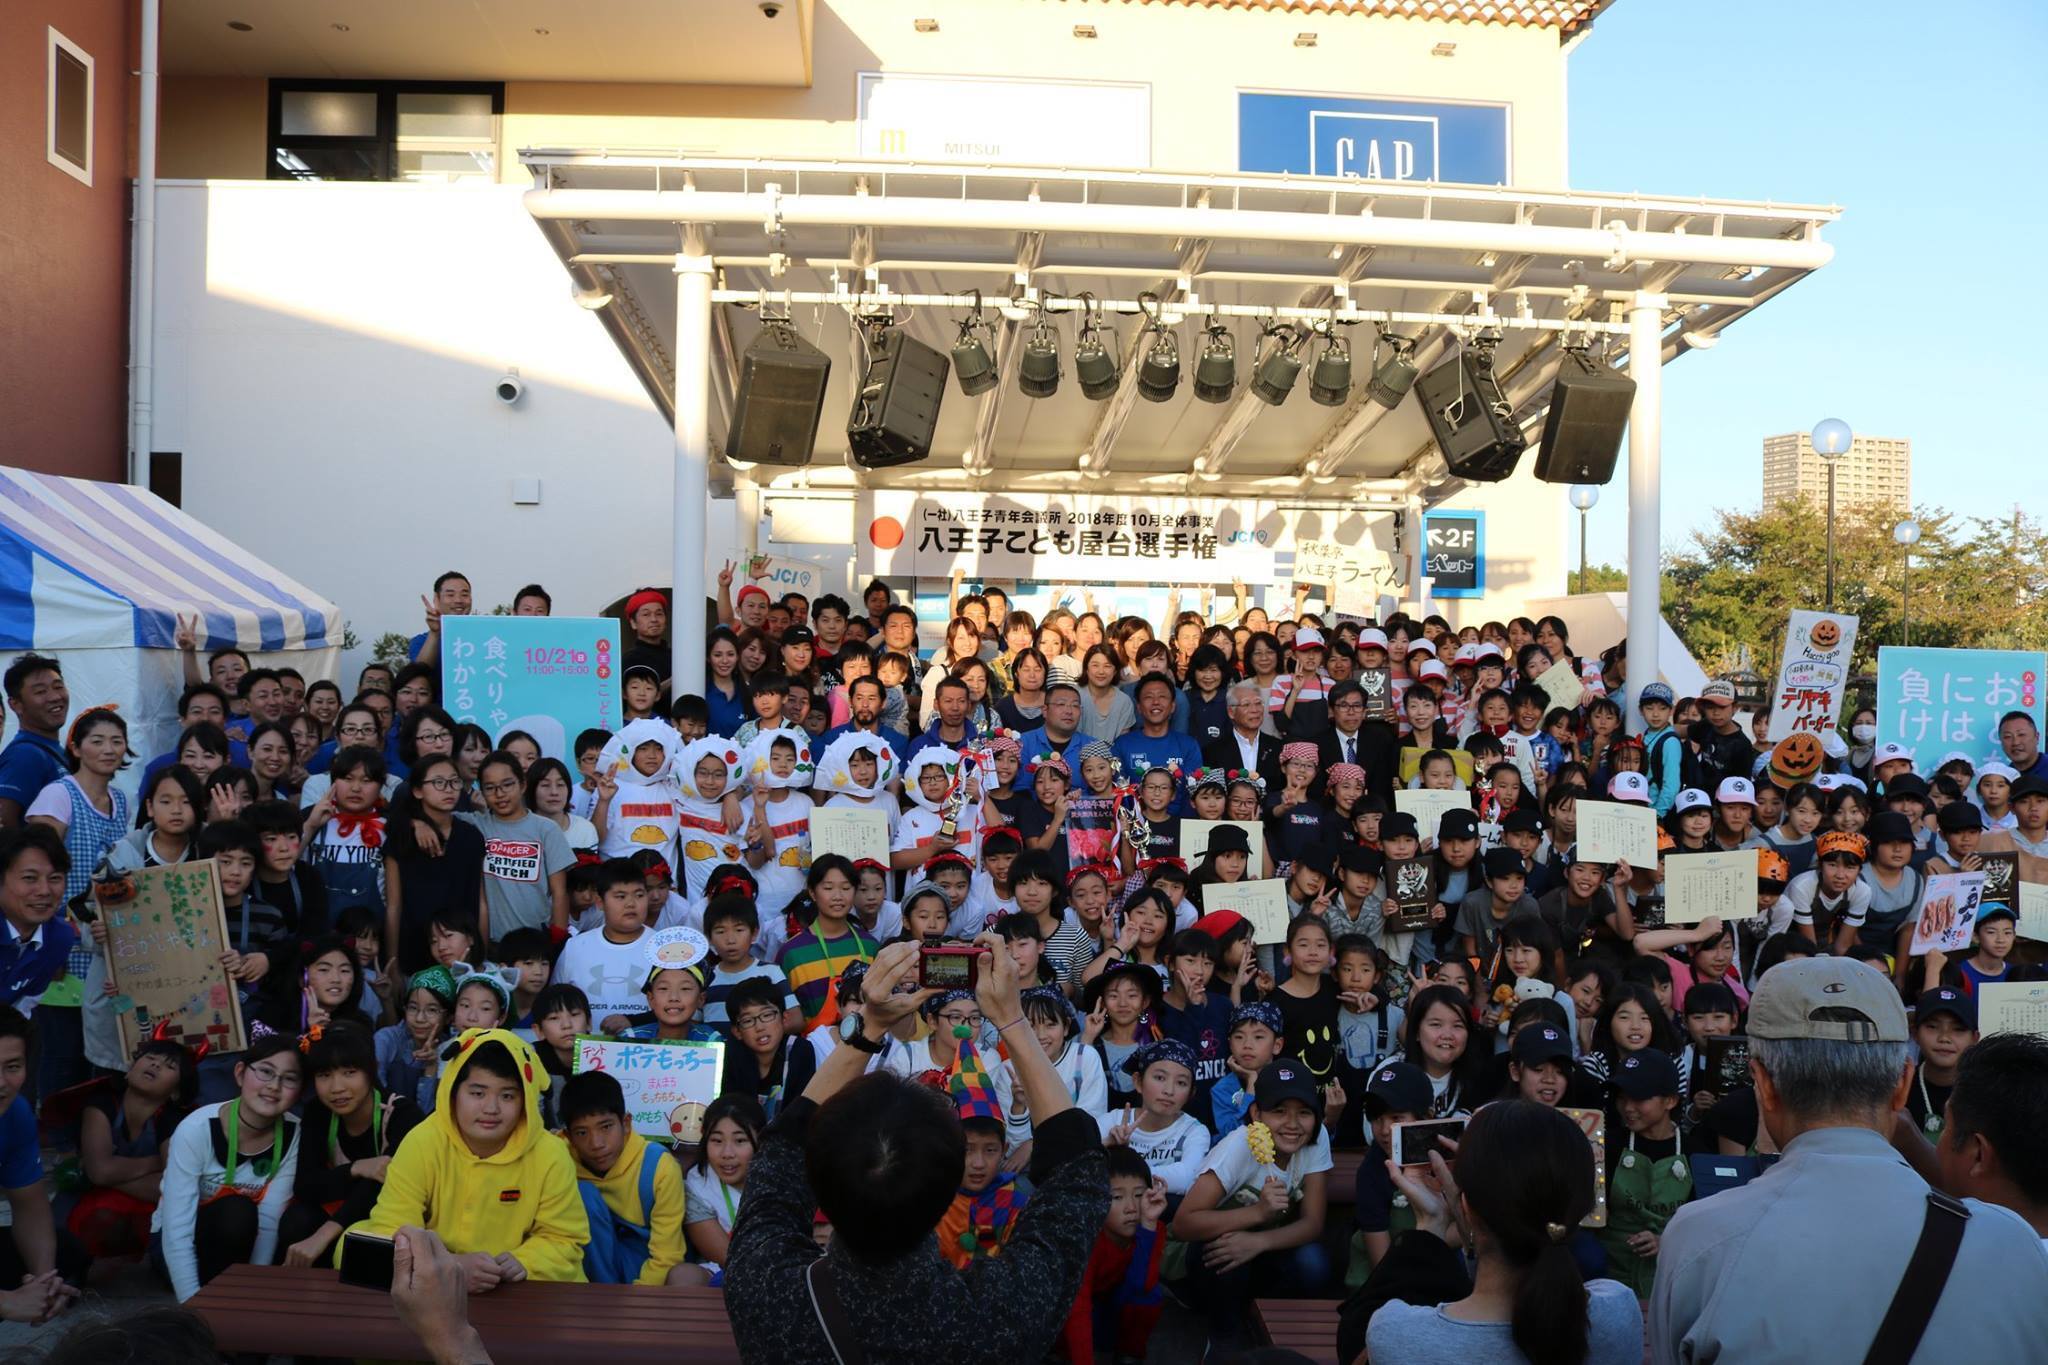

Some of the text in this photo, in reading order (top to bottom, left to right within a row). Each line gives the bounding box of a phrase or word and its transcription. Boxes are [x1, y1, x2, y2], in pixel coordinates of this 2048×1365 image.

[1336, 137, 1413, 180] GAP
[918, 527, 1218, 559] 八王子こども屋台選手権
[1228, 530, 1255, 544] JCI
[1445, 527, 1476, 548] 2F
[770, 568, 798, 584] JCI
[1781, 687, 1832, 713] テリヤキ
[1941, 671, 1977, 743] には
[1791, 714, 1836, 733] バーガー
[490, 843, 530, 855] DANGER
[489, 863, 529, 878] BITCH
[611, 1003, 650, 1011] ARMOU
[589, 1056, 606, 1071] 2
[615, 1045, 717, 1071] ポテもっちー
